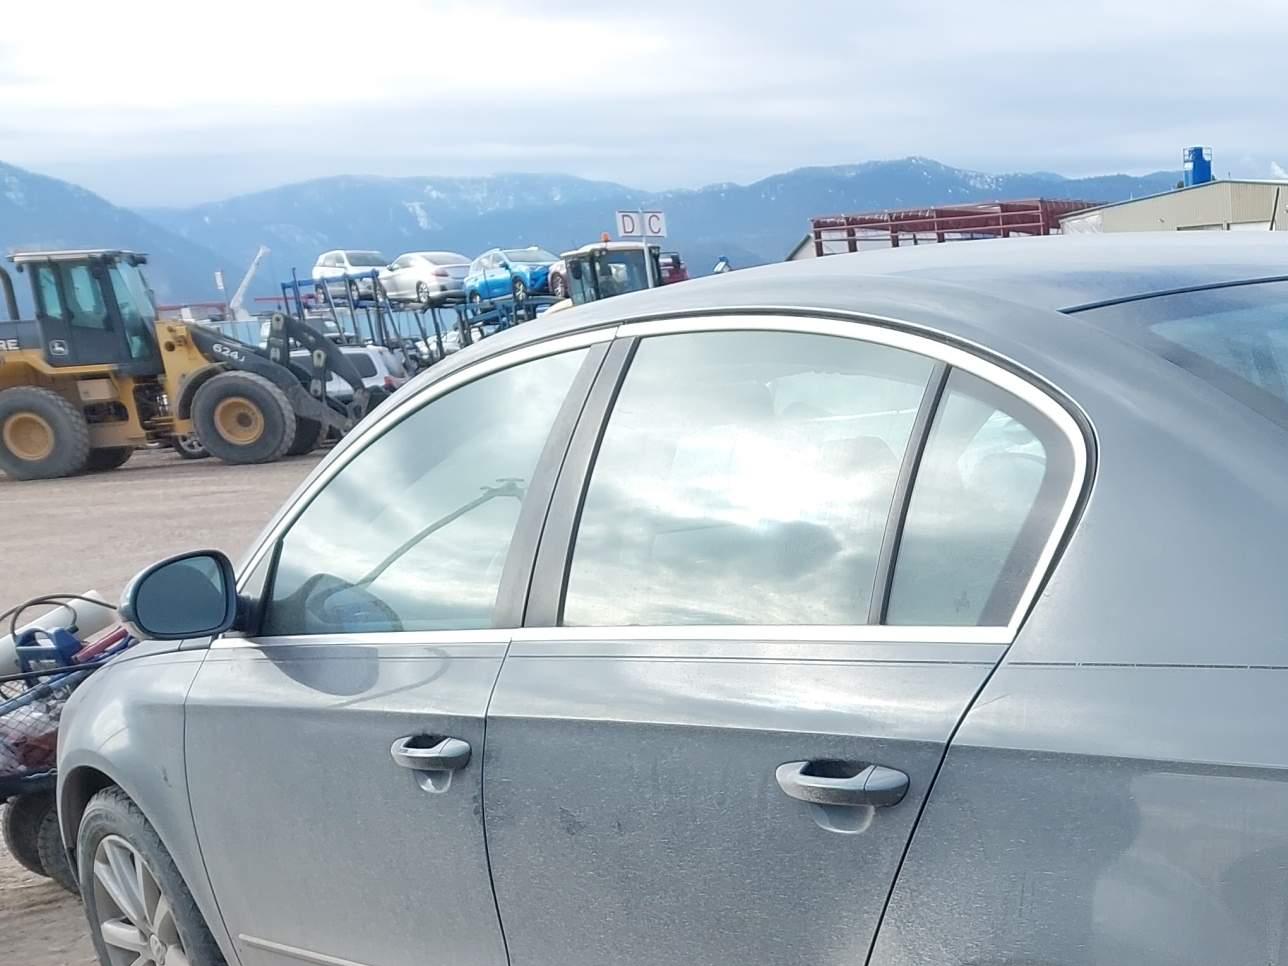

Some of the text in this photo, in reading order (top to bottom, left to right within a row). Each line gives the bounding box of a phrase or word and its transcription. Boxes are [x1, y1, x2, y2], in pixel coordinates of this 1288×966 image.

[621, 214, 662, 234] D C
[212, 343, 246, 362] 624J
